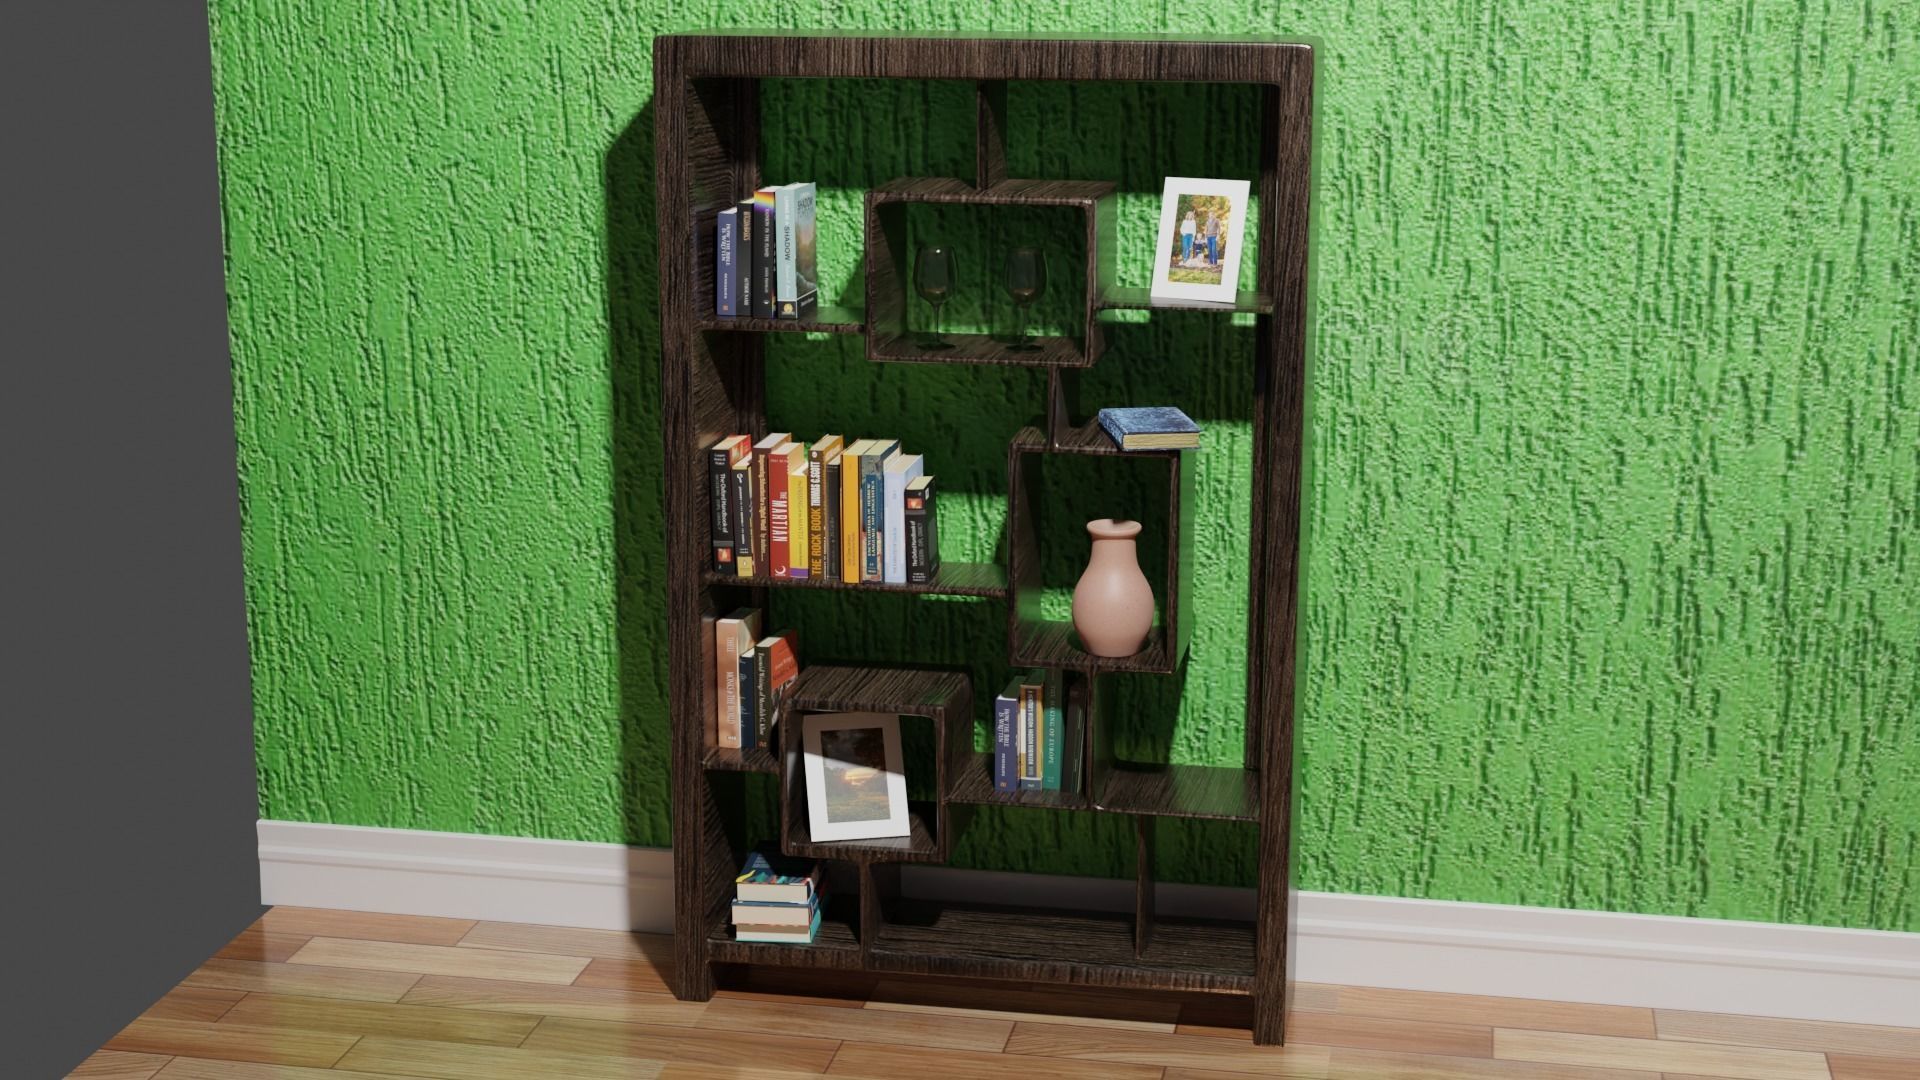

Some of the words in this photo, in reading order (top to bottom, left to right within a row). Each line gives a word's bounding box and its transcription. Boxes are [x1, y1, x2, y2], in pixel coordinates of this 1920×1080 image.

[811, 484, 820, 506] THOMAS
[772, 500, 788, 542] MARTIAN
[811, 508, 821, 531] BOOK
[811, 533, 821, 556] ROCK
[812, 559, 821, 574] THE
[1050, 728, 1055, 737] OF
